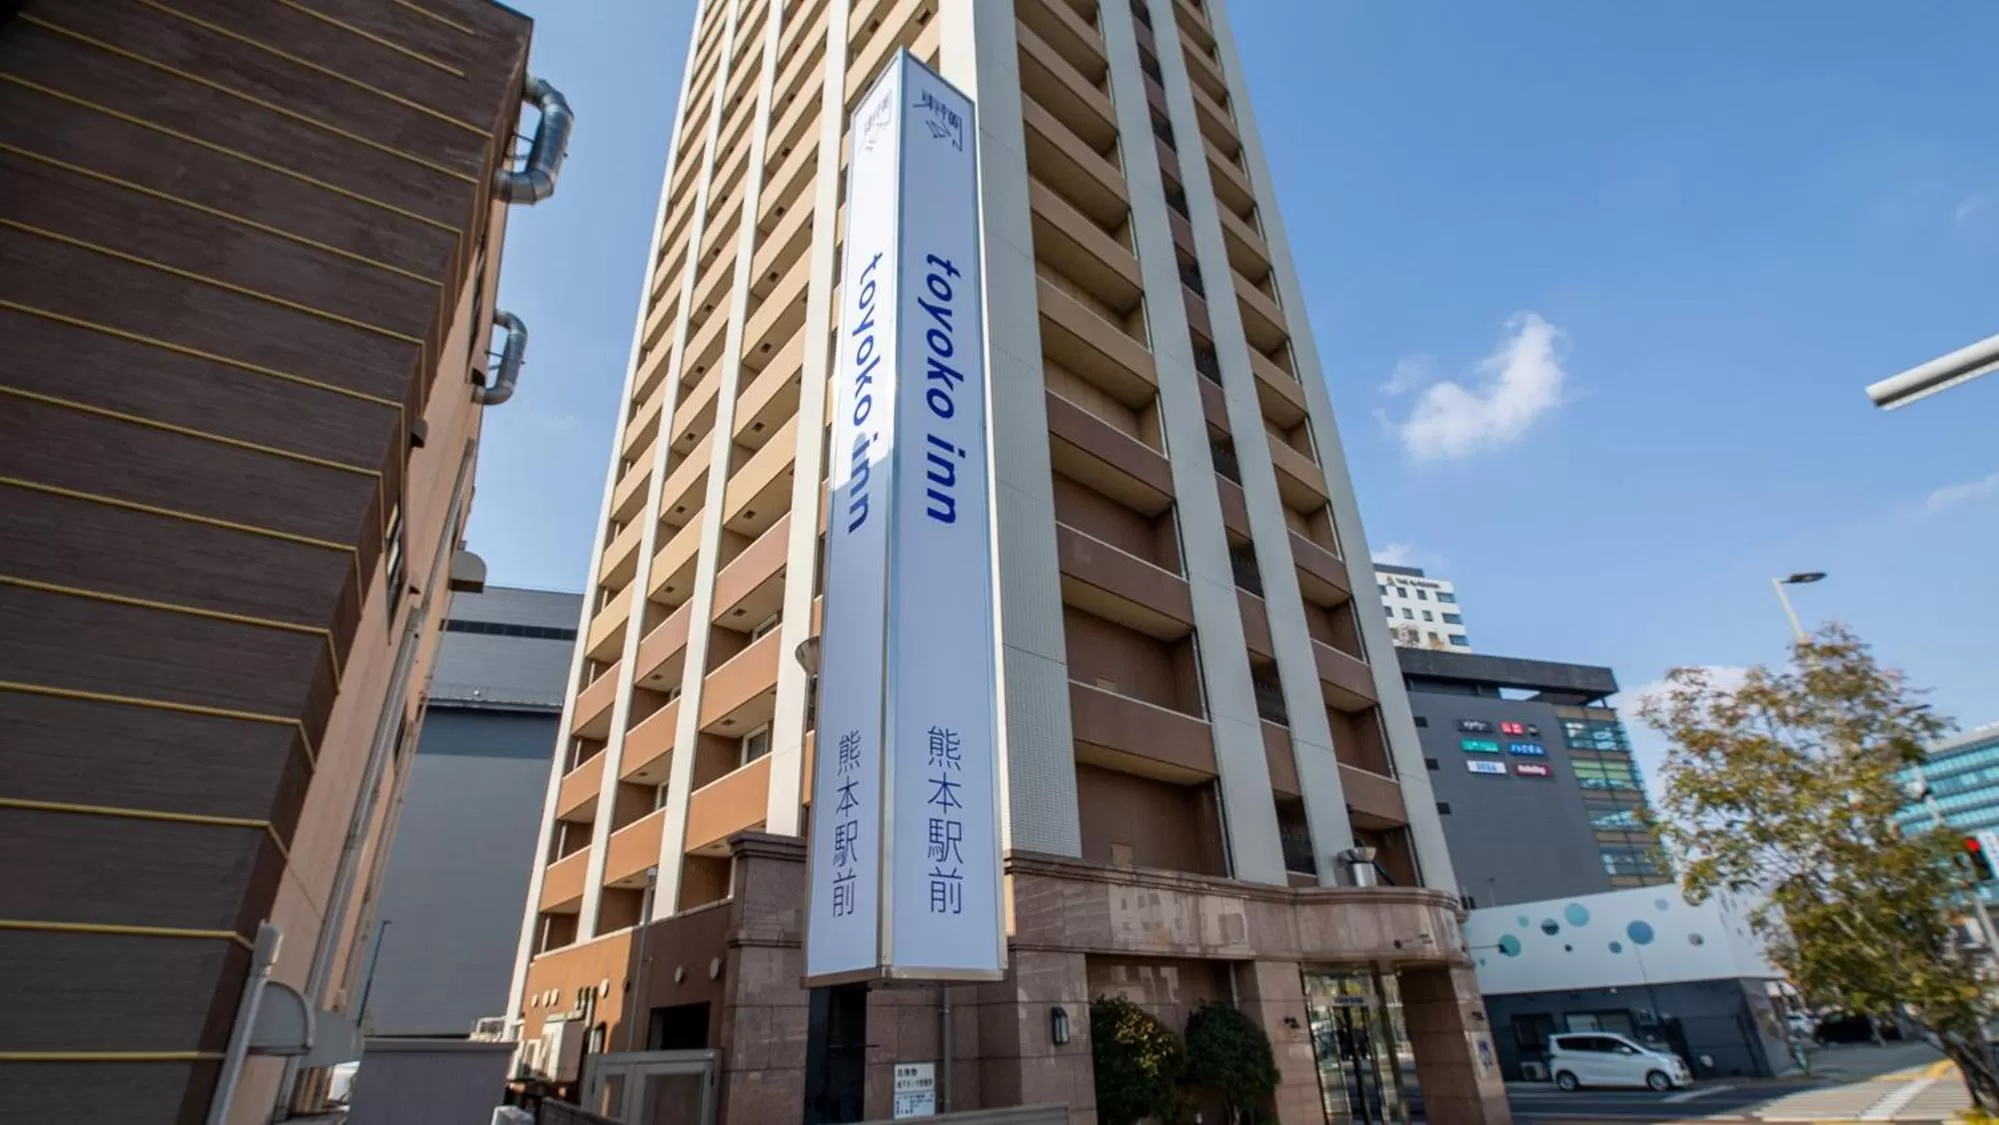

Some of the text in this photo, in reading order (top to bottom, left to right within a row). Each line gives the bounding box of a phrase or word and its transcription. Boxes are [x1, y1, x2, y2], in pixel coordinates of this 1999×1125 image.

[848, 252, 882, 533] toyoko inn
[917, 253, 966, 524] toyoko inn
[833, 729, 861, 918] 熊本駅前
[927, 725, 964, 915] 熊本駅前
